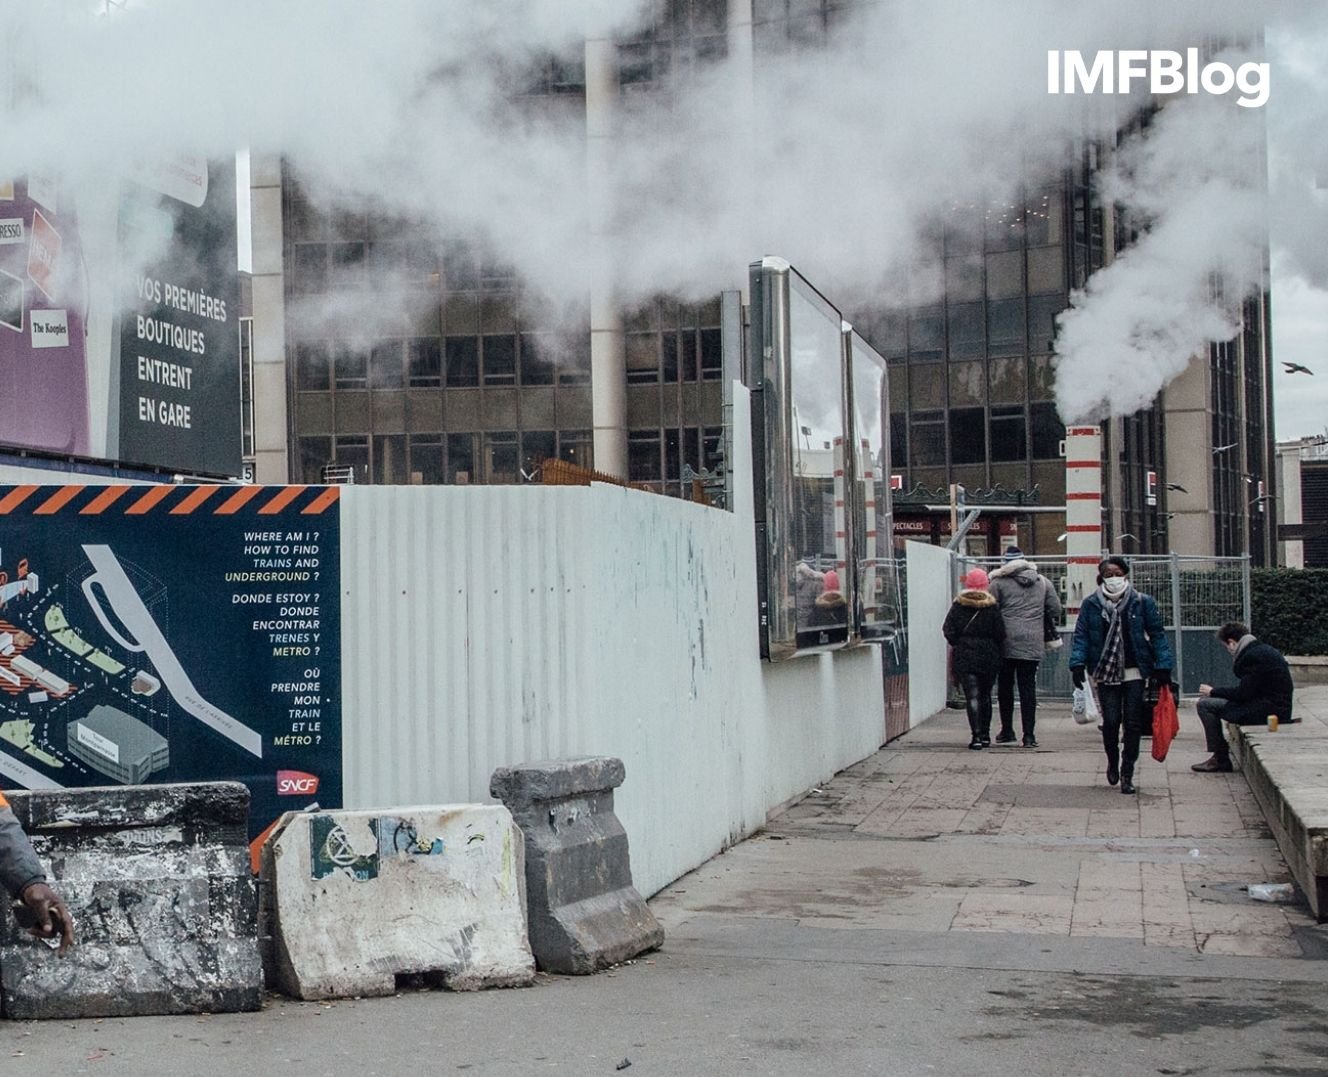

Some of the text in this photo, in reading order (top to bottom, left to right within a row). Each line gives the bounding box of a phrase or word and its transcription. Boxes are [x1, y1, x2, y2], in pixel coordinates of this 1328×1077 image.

[136, 275, 227, 323] VOS PREMIÈRES
[33, 321, 67, 335] The Kooples
[136, 314, 206, 355] BOUTIQUES
[137, 355, 193, 390] ENTRENT
[138, 396, 192, 429] EN GARE
[244, 532, 283, 542] WHERE
[285, 532, 303, 542] AM
[313, 532, 320, 541] ?
[244, 545, 320, 555] HOW TO FIND
[253, 558, 320, 568] TRAINS AND
[224, 571, 320, 582] UNDERGROUND ?
[232, 593, 321, 604] DONDE ESTOY ?
[280, 606, 320, 617] DONDE
[252, 620, 321, 630] ENCONTRAR
[269, 633, 321, 643] TRENES Y
[272, 646, 321, 657] METRO ?
[304, 666, 321, 679] OÙ
[270, 682, 321, 693] PRENDRE
[294, 695, 321, 706] MON
[288, 709, 321, 719] TRAIN
[292, 722, 321, 732] ET LE
[273, 734, 322, 746] MÉTRO ?
[279, 778, 317, 792] SNCF
